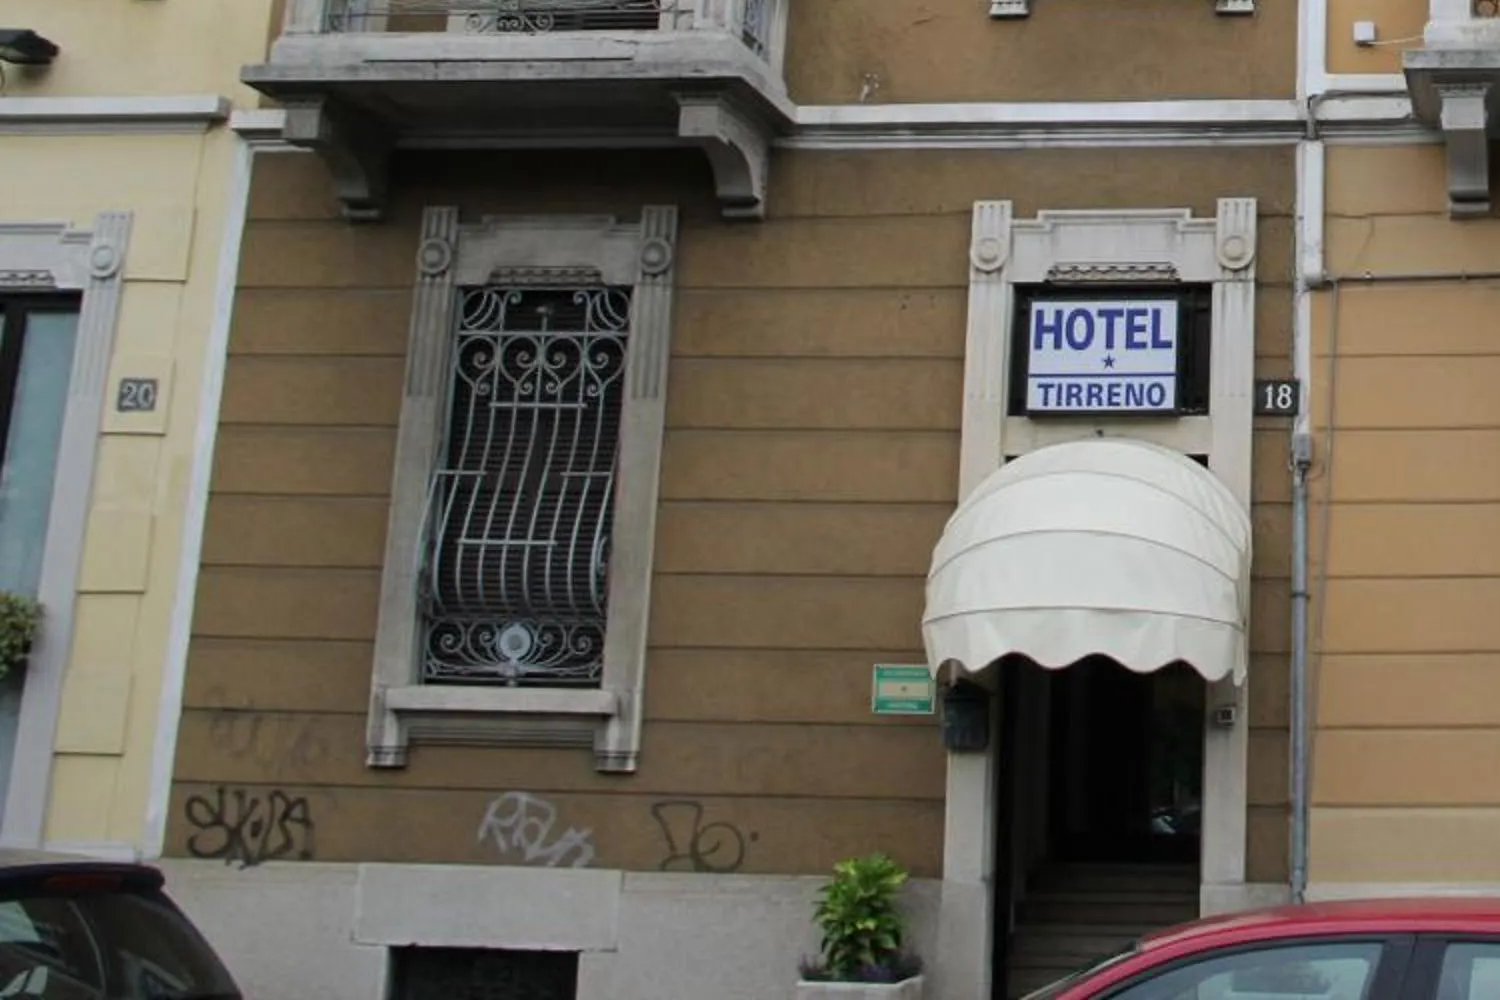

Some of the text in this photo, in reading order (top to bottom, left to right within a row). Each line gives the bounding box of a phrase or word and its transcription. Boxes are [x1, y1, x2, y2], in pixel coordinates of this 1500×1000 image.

[1033, 307, 1173, 351] HOTEL
[121, 382, 155, 408] 20
[1037, 382, 1167, 408] TIRRENO
[1263, 383, 1293, 410] 18
